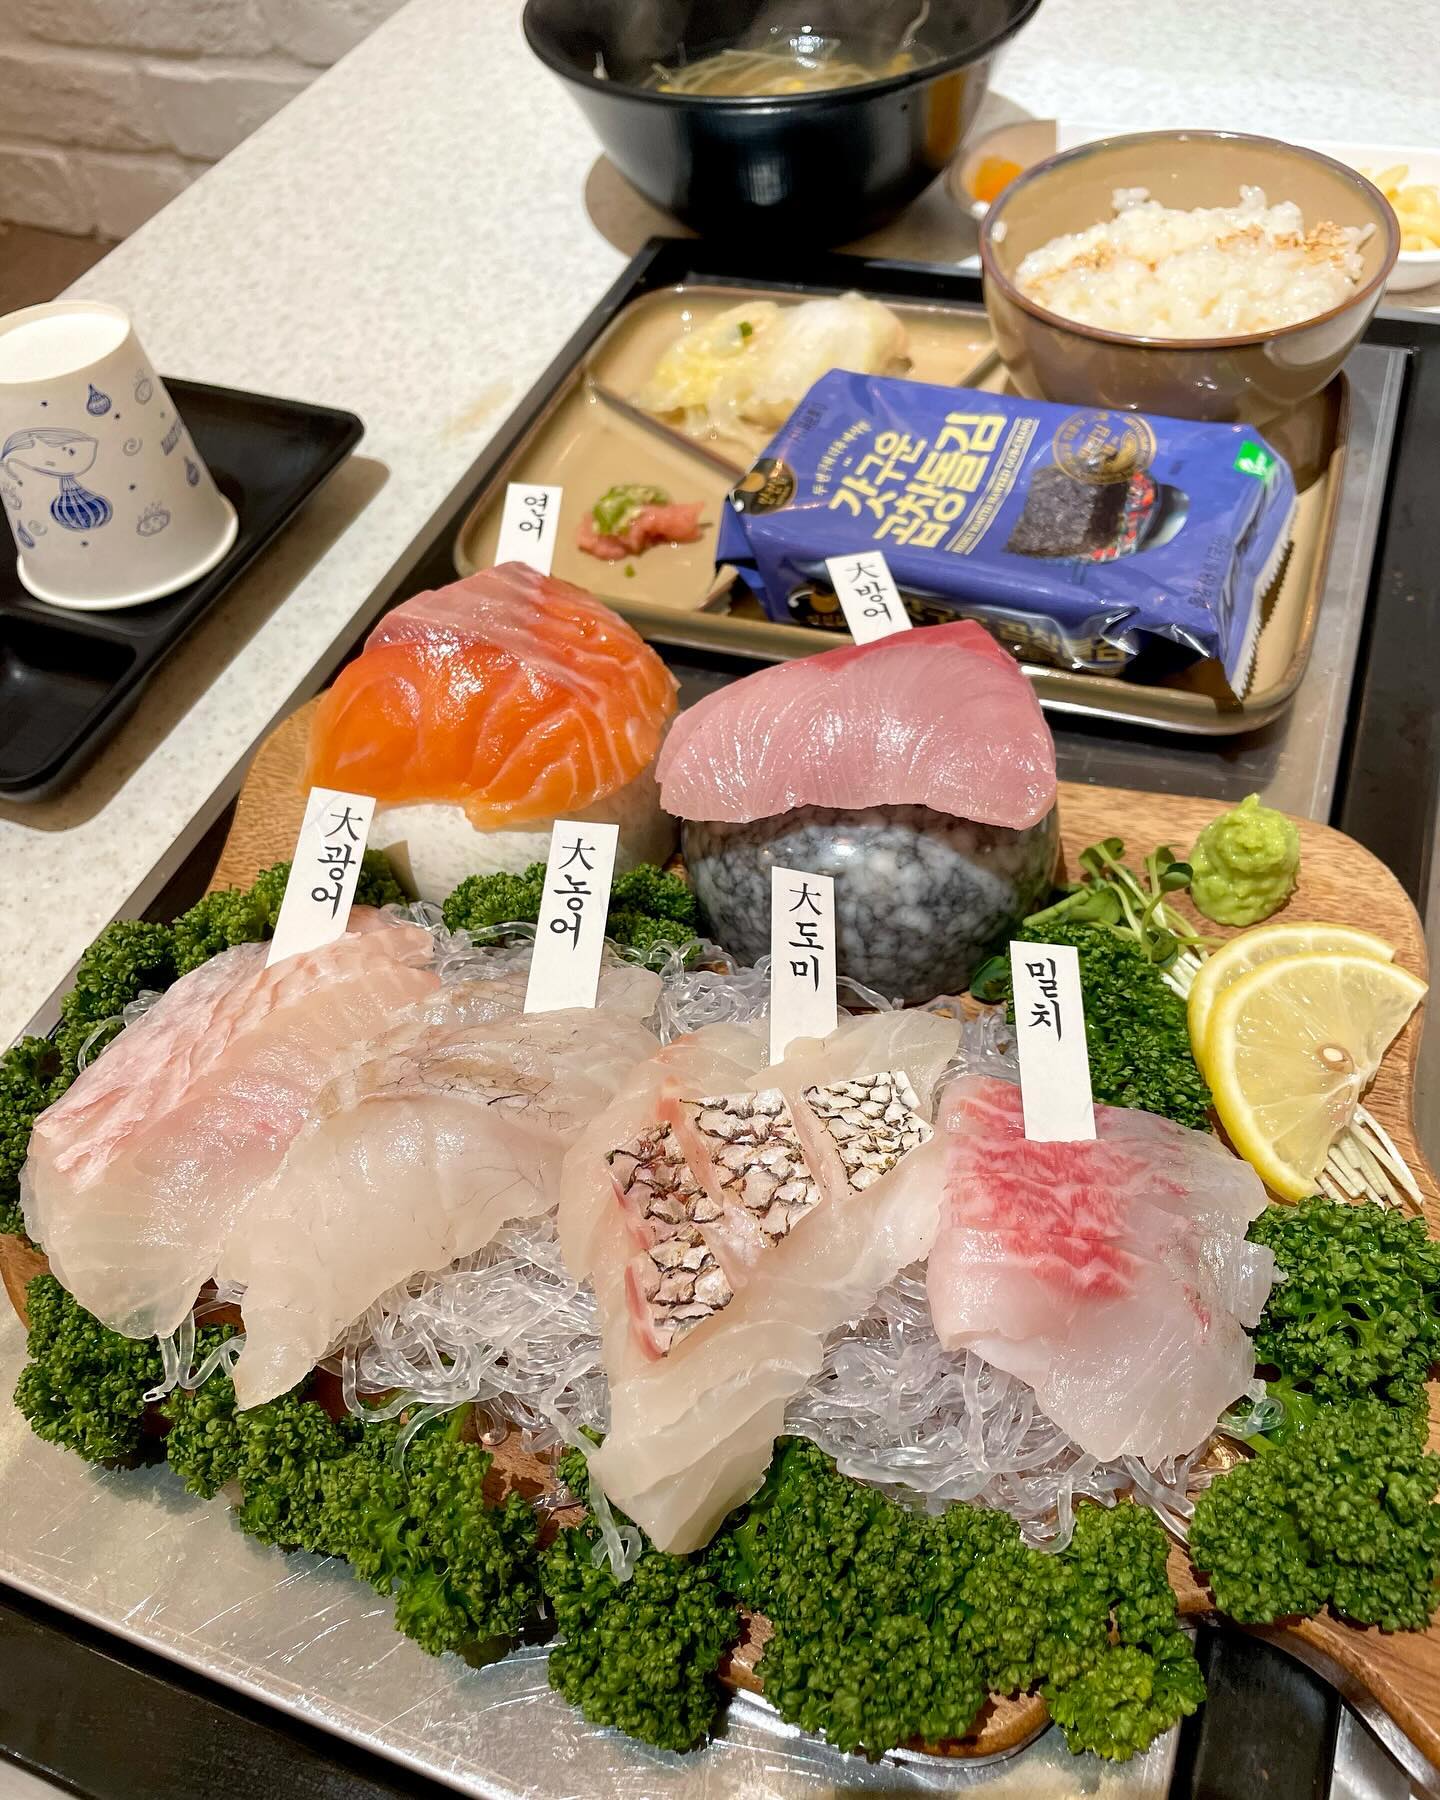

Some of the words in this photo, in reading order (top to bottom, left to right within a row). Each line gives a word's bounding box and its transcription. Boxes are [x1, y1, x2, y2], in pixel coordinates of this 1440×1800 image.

[519, 491, 549, 542] 연어
[828, 431, 928, 520] 갓구운
[872, 412, 1008, 549] 곱창돌김
[1024, 957, 1063, 1043] 밀치
